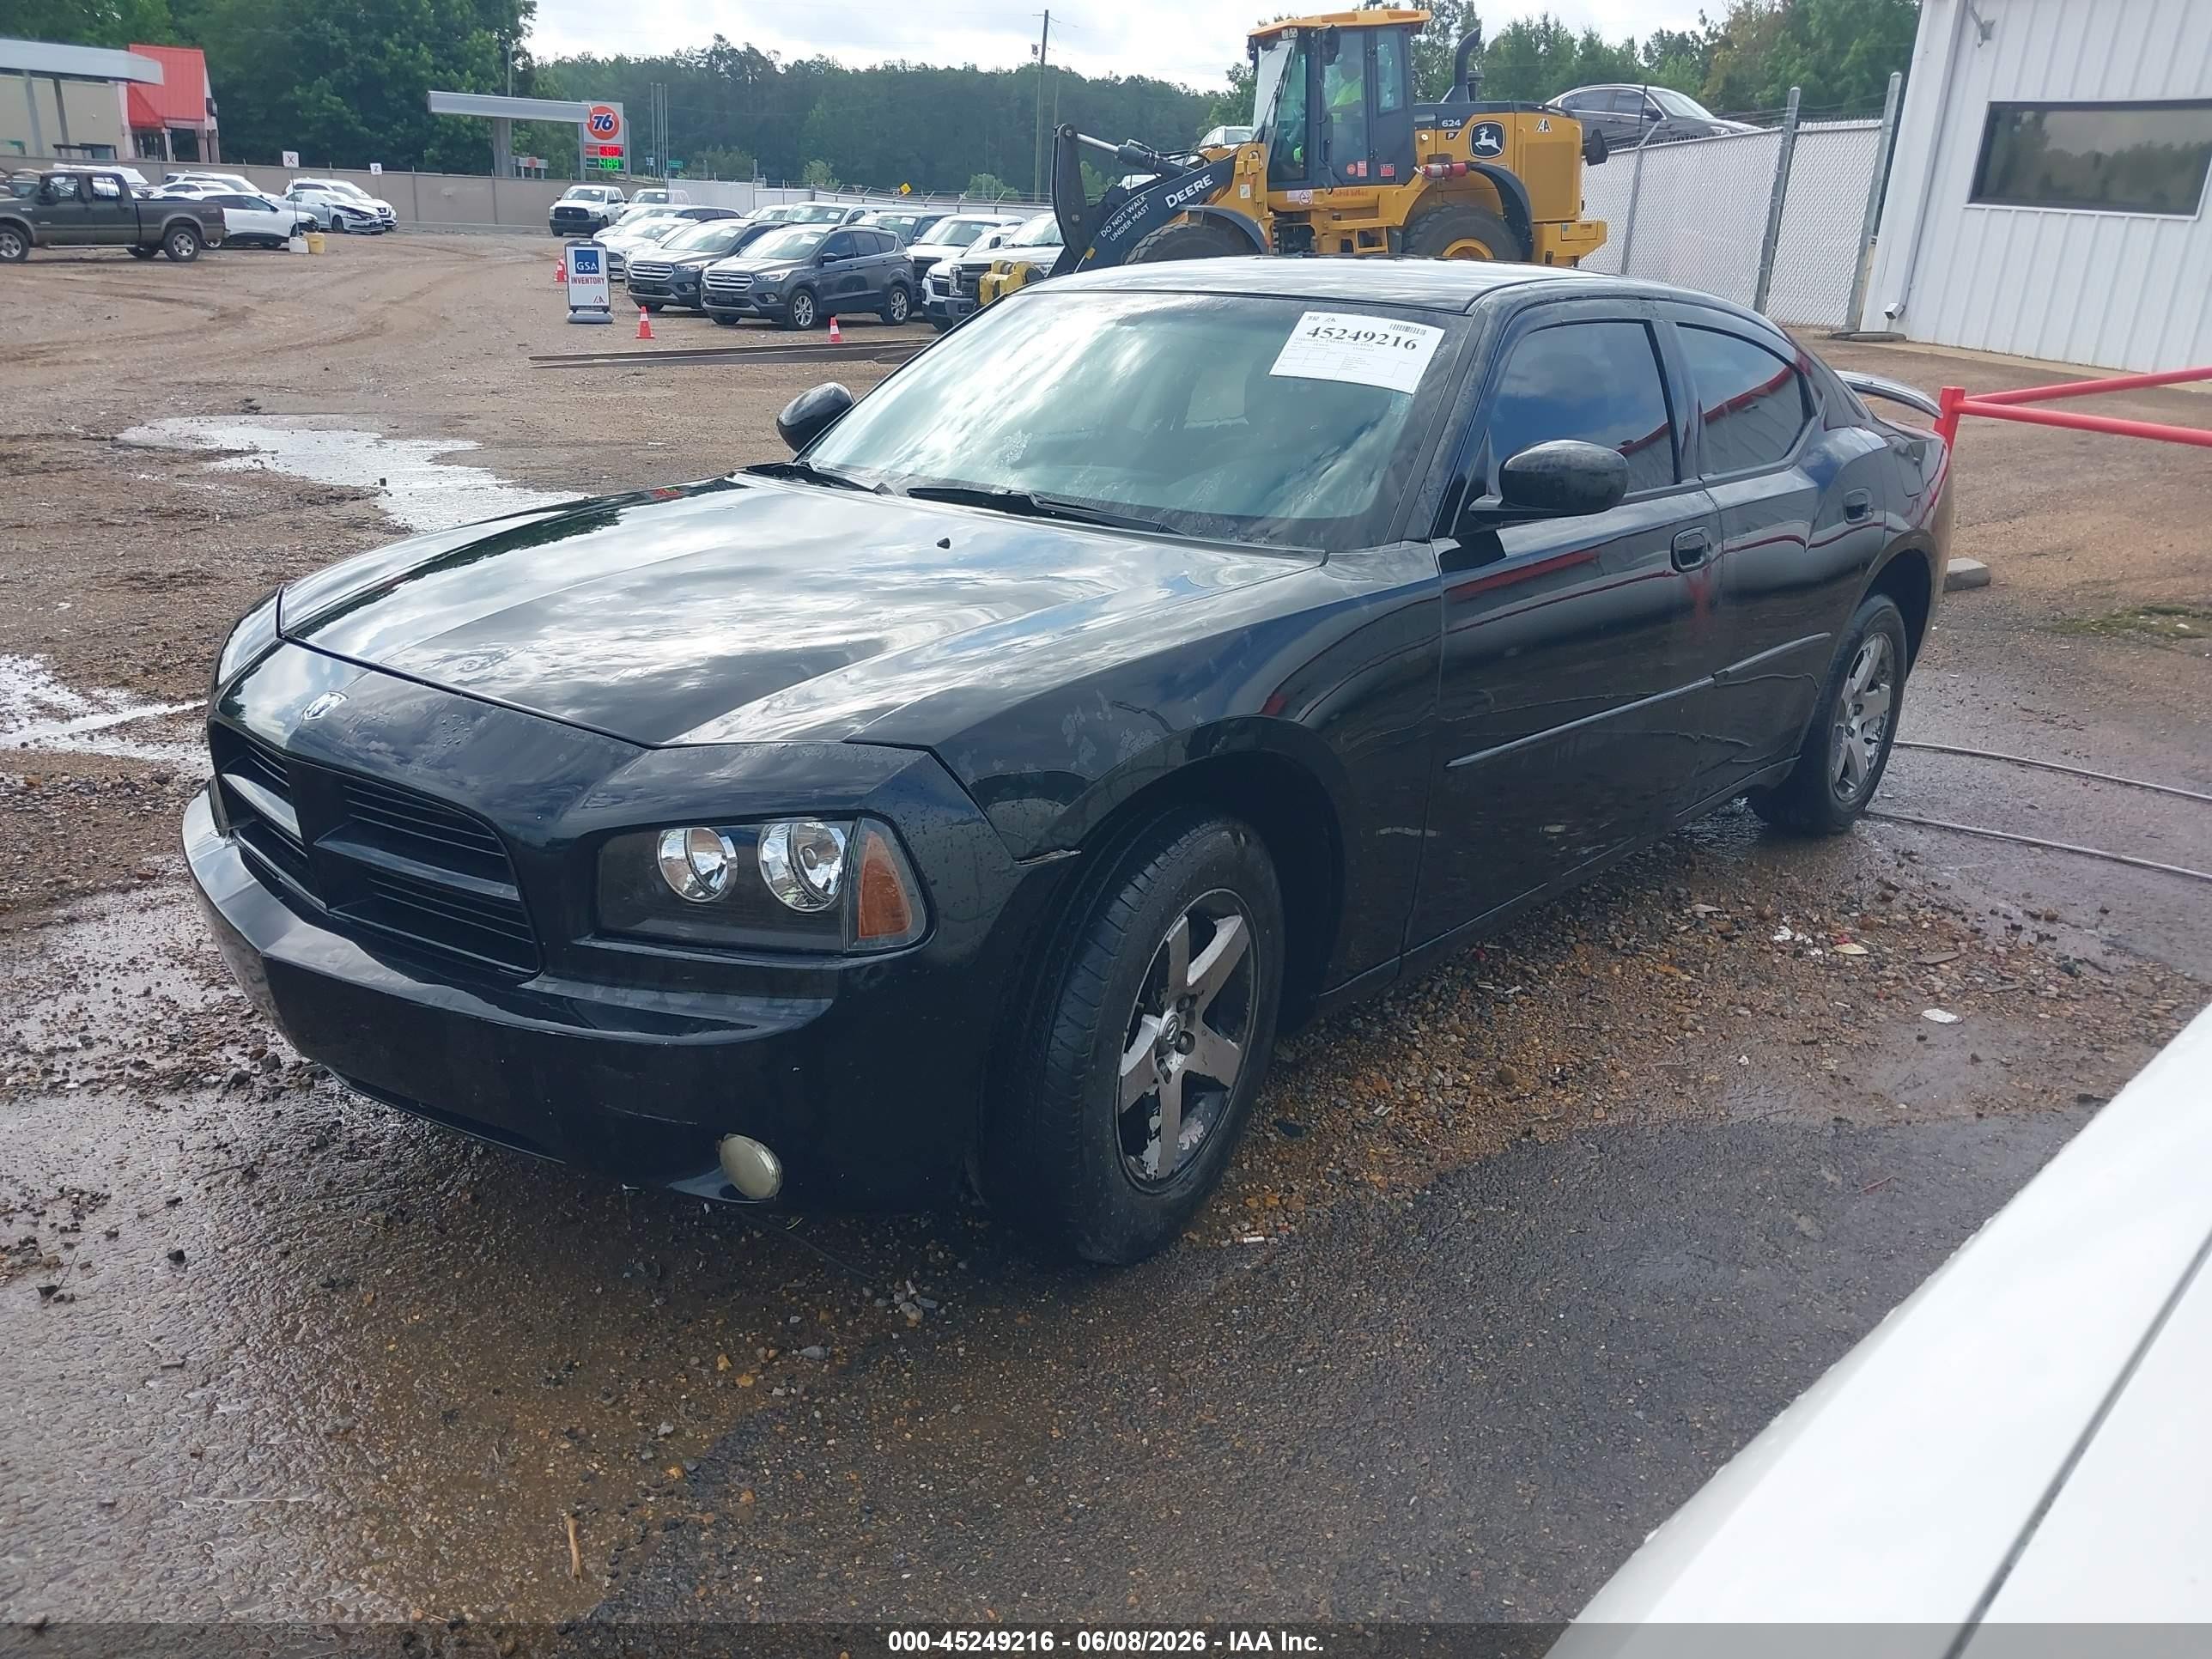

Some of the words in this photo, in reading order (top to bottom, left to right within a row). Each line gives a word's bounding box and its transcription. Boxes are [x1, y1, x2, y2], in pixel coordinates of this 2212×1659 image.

[592, 112, 615, 131] 76
[1164, 174, 1213, 208] DEERE
[1101, 227, 1112, 237] DO
[1112, 210, 1127, 226] NOT
[1126, 195, 1148, 214] WALK
[1109, 218, 1133, 241] UNDER
[1133, 204, 1150, 222] MAST
[576, 261, 599, 270] GSA
[1306, 326, 1419, 350] 45249216
